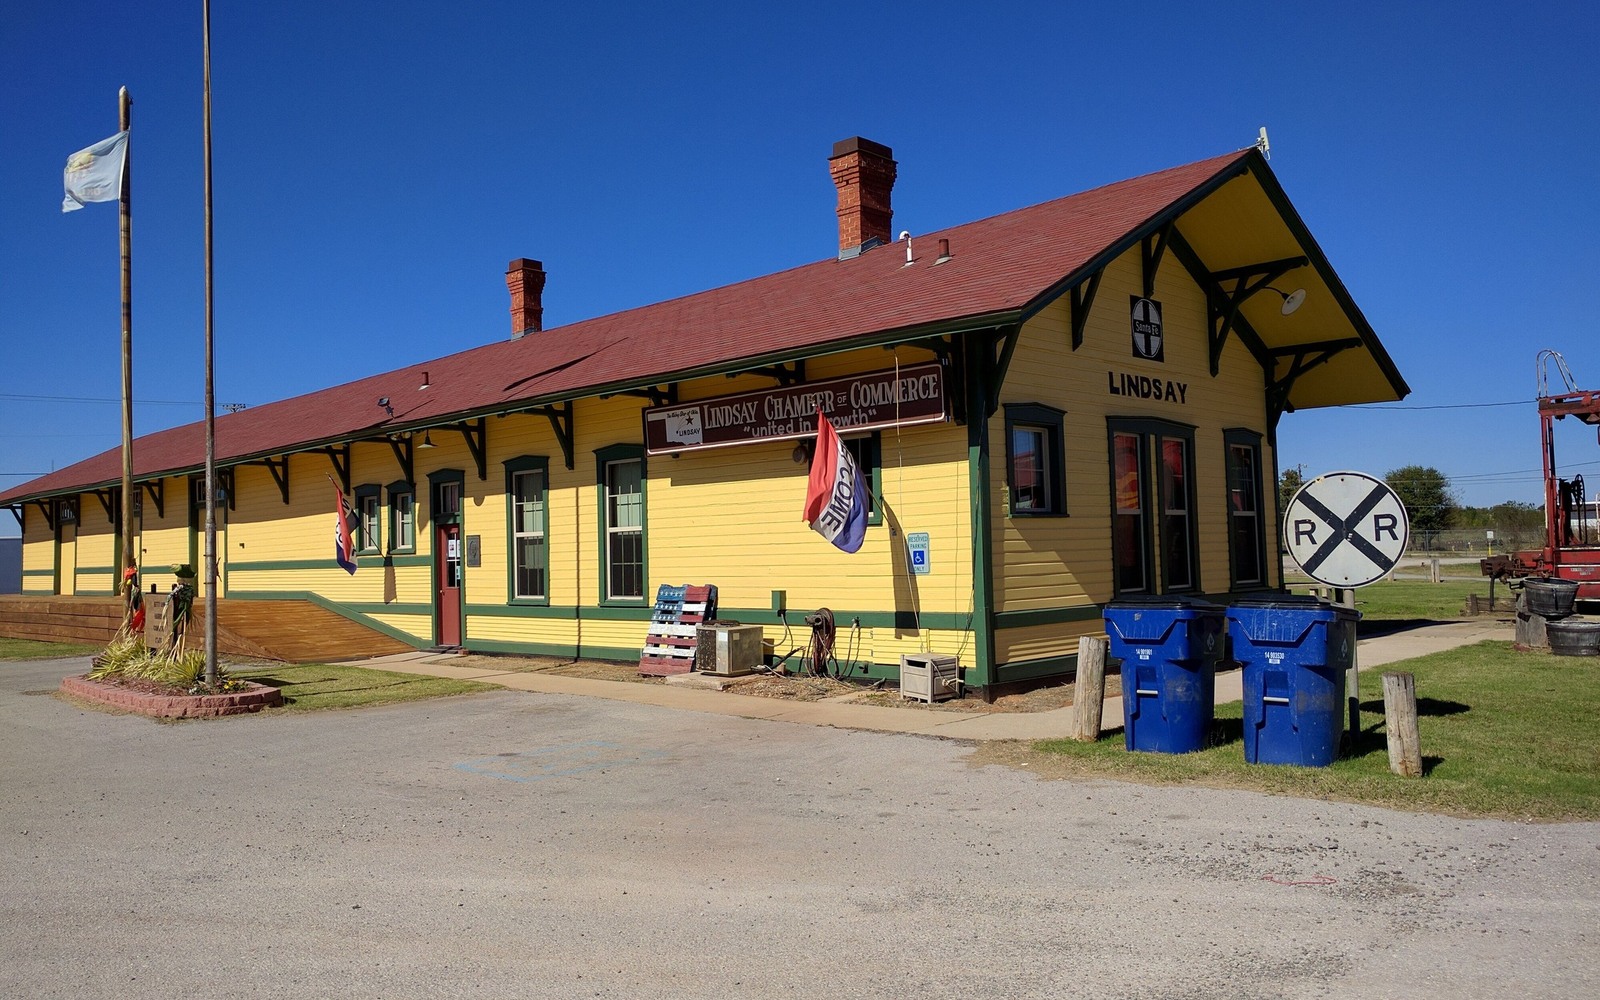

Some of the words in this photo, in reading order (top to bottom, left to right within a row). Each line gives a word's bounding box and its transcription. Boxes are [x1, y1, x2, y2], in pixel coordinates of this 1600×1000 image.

[1135, 321, 1151, 333] Santa
[1152, 324, 1159, 335] Fe
[703, 401, 758, 429] LINDSAY
[764, 390, 835, 420] CHAMBER
[837, 395, 847, 403] OF
[850, 373, 939, 409] COMMERCE
[1108, 371, 1187, 404] LINDSAY
[679, 428, 701, 436] LINDSAY
[800, 417, 812, 433] in
[828, 408, 877, 429] rowth"
[1294, 519, 1317, 546] R
[1374, 513, 1399, 541] R
